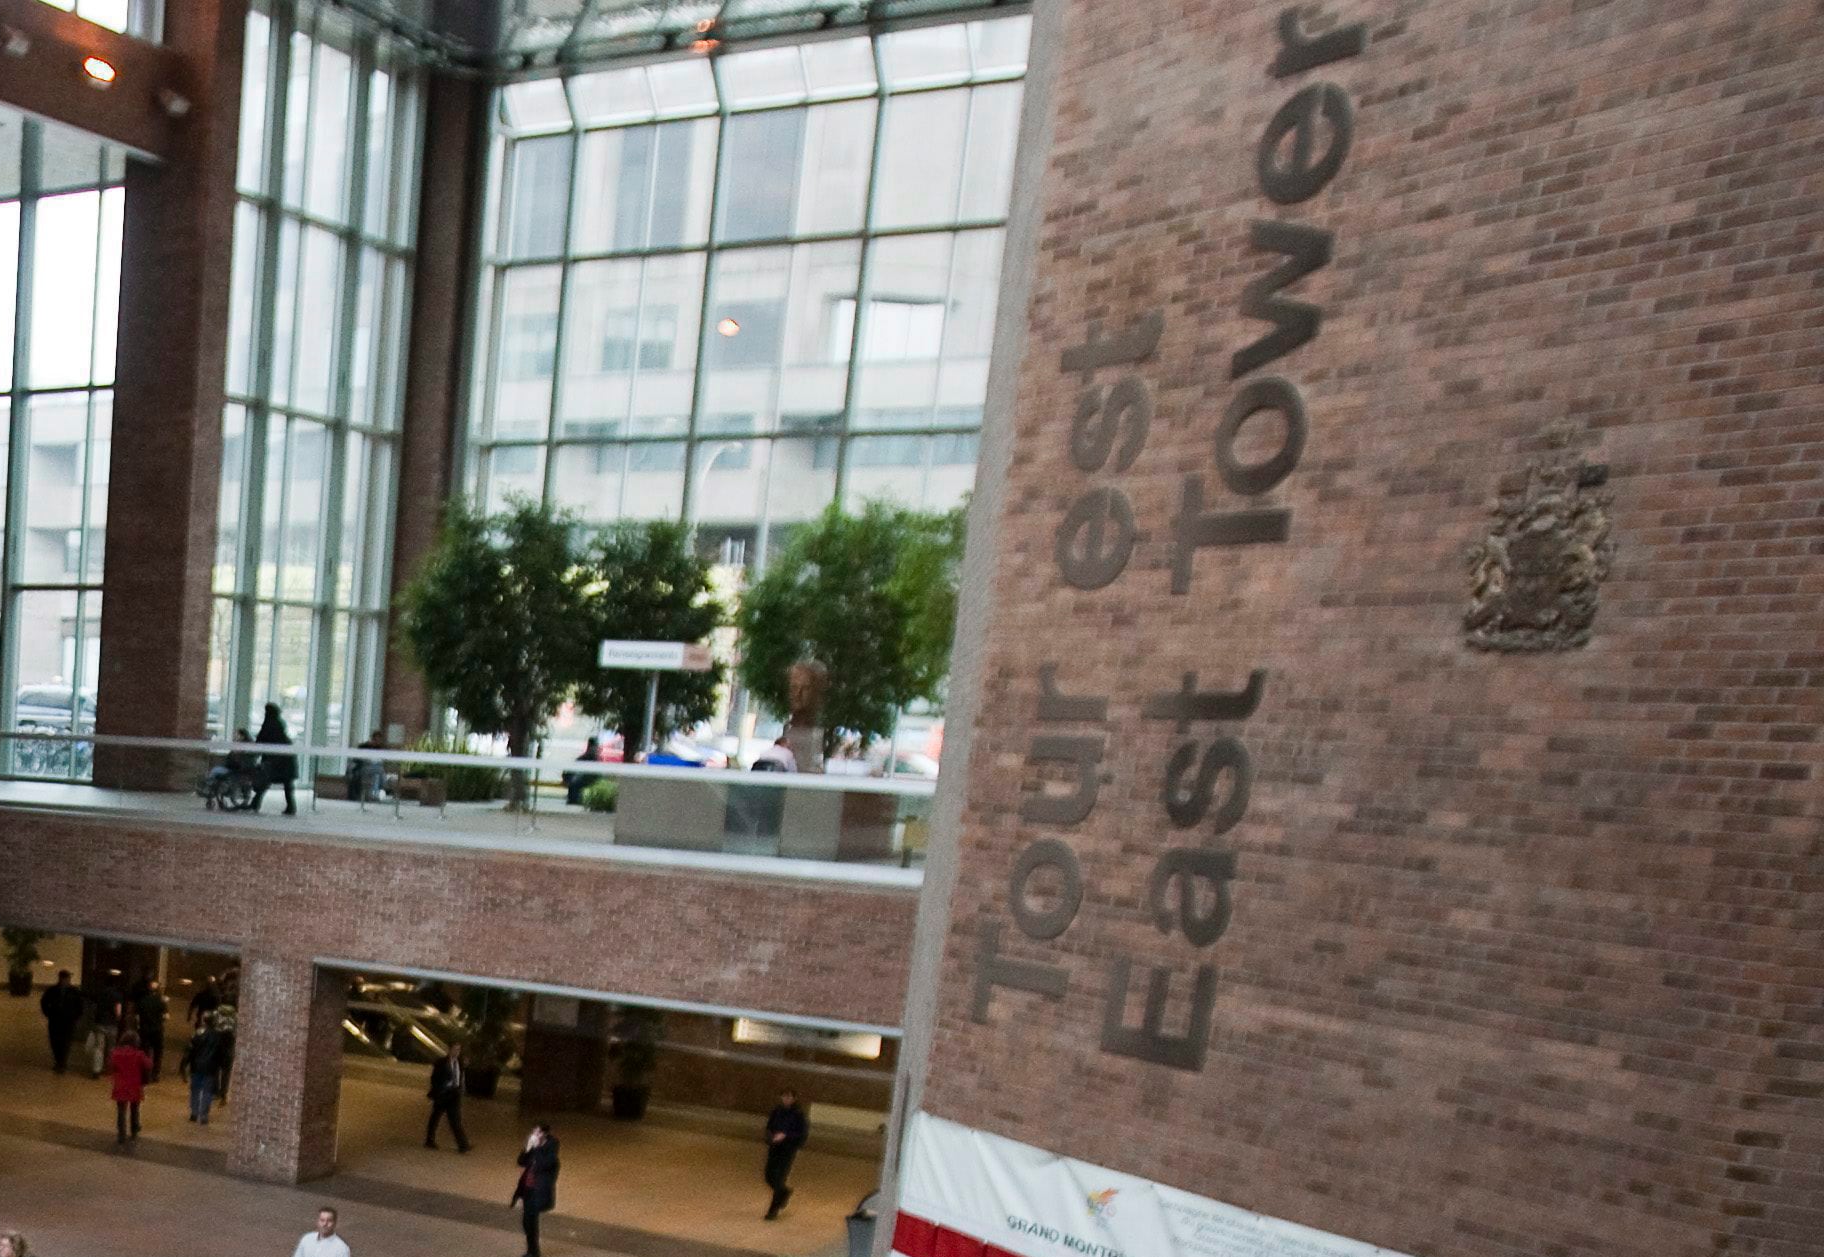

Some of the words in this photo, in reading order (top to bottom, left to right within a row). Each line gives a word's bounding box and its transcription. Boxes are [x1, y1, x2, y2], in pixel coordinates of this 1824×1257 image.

[1170, 5, 1368, 595] Tower
[972, 660, 1110, 1025] Tour
[1054, 307, 1166, 592] est
[1099, 667, 1267, 1073] East
[1006, 1214, 1060, 1243] GRAND
